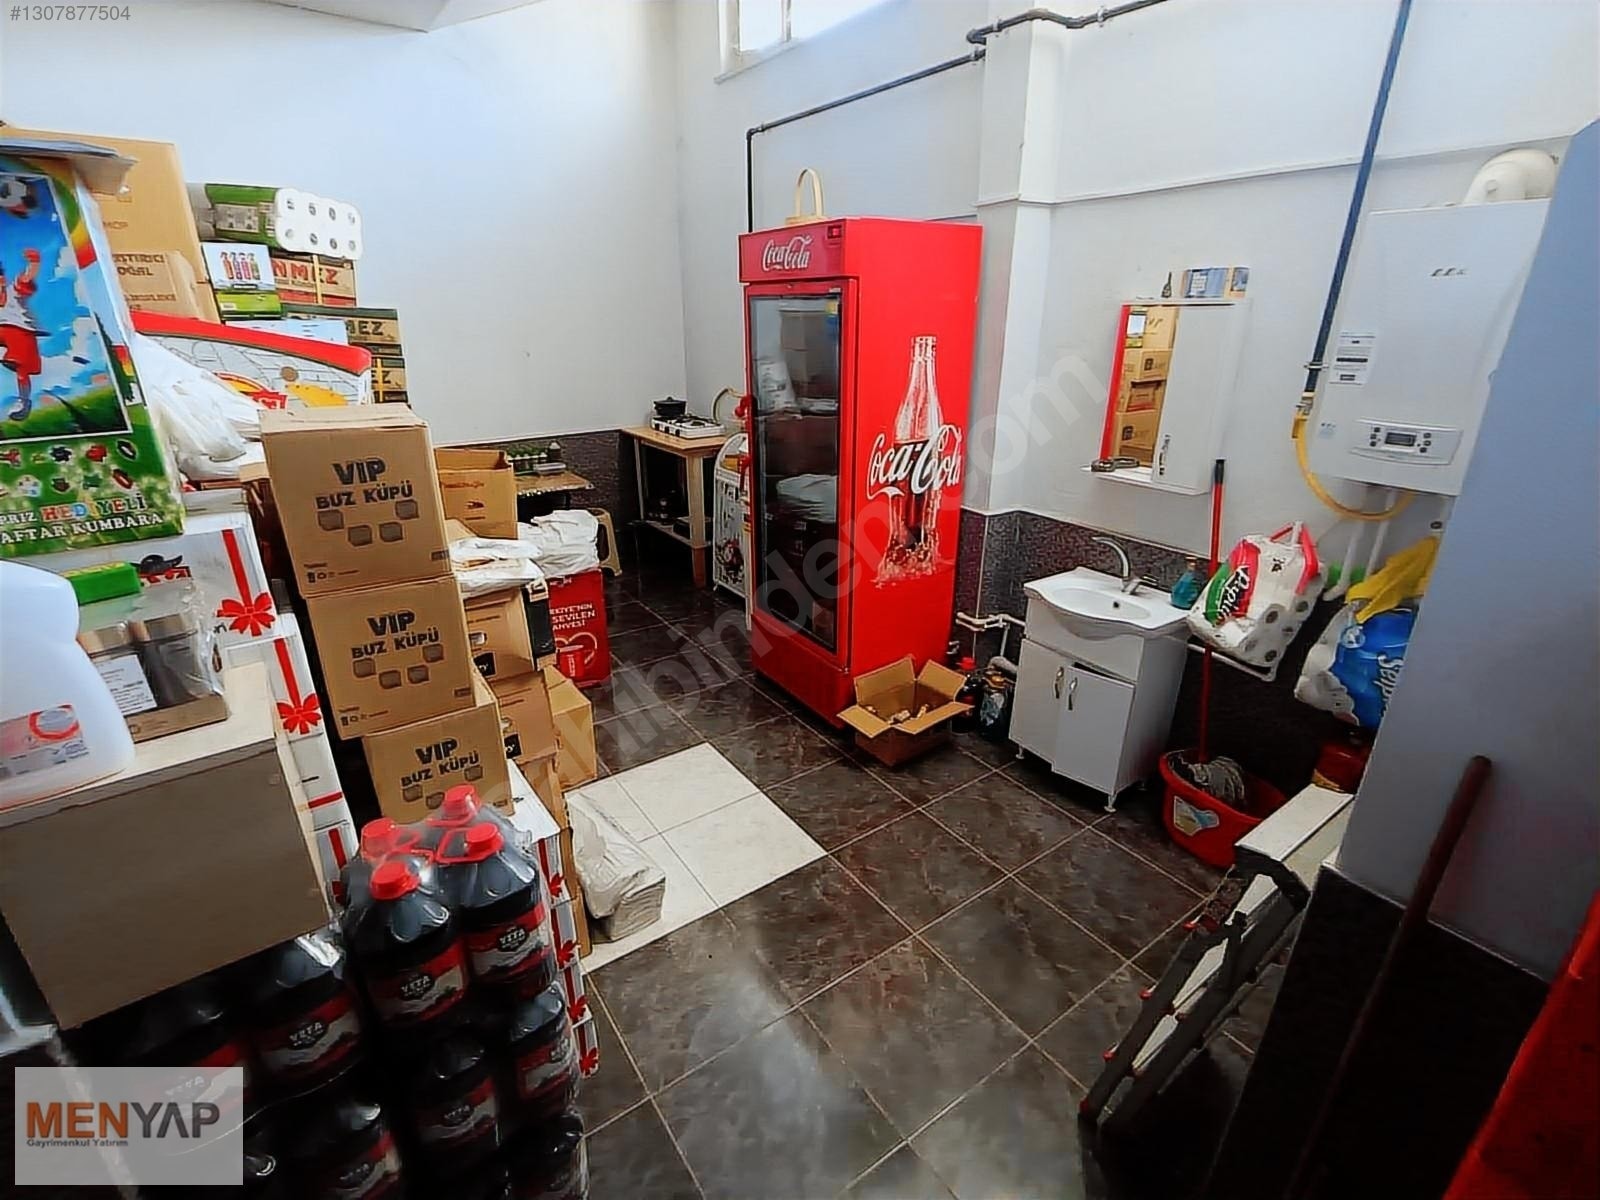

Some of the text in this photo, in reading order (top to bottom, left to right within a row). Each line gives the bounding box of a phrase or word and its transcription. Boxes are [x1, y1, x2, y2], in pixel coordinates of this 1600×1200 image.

[332, 457, 386, 486] VIP
[866, 424, 962, 500] Coca-Cola
[315, 480, 413, 510] BUZ KÜPÜ
[71, 512, 163, 534] KUMBARA
[367, 610, 415, 636] VIP
[351, 627, 440, 659] BUZ KÜPÜ
[415, 737, 458, 765] VIP
[401, 750, 479, 787] BUZ KÜPÜ
